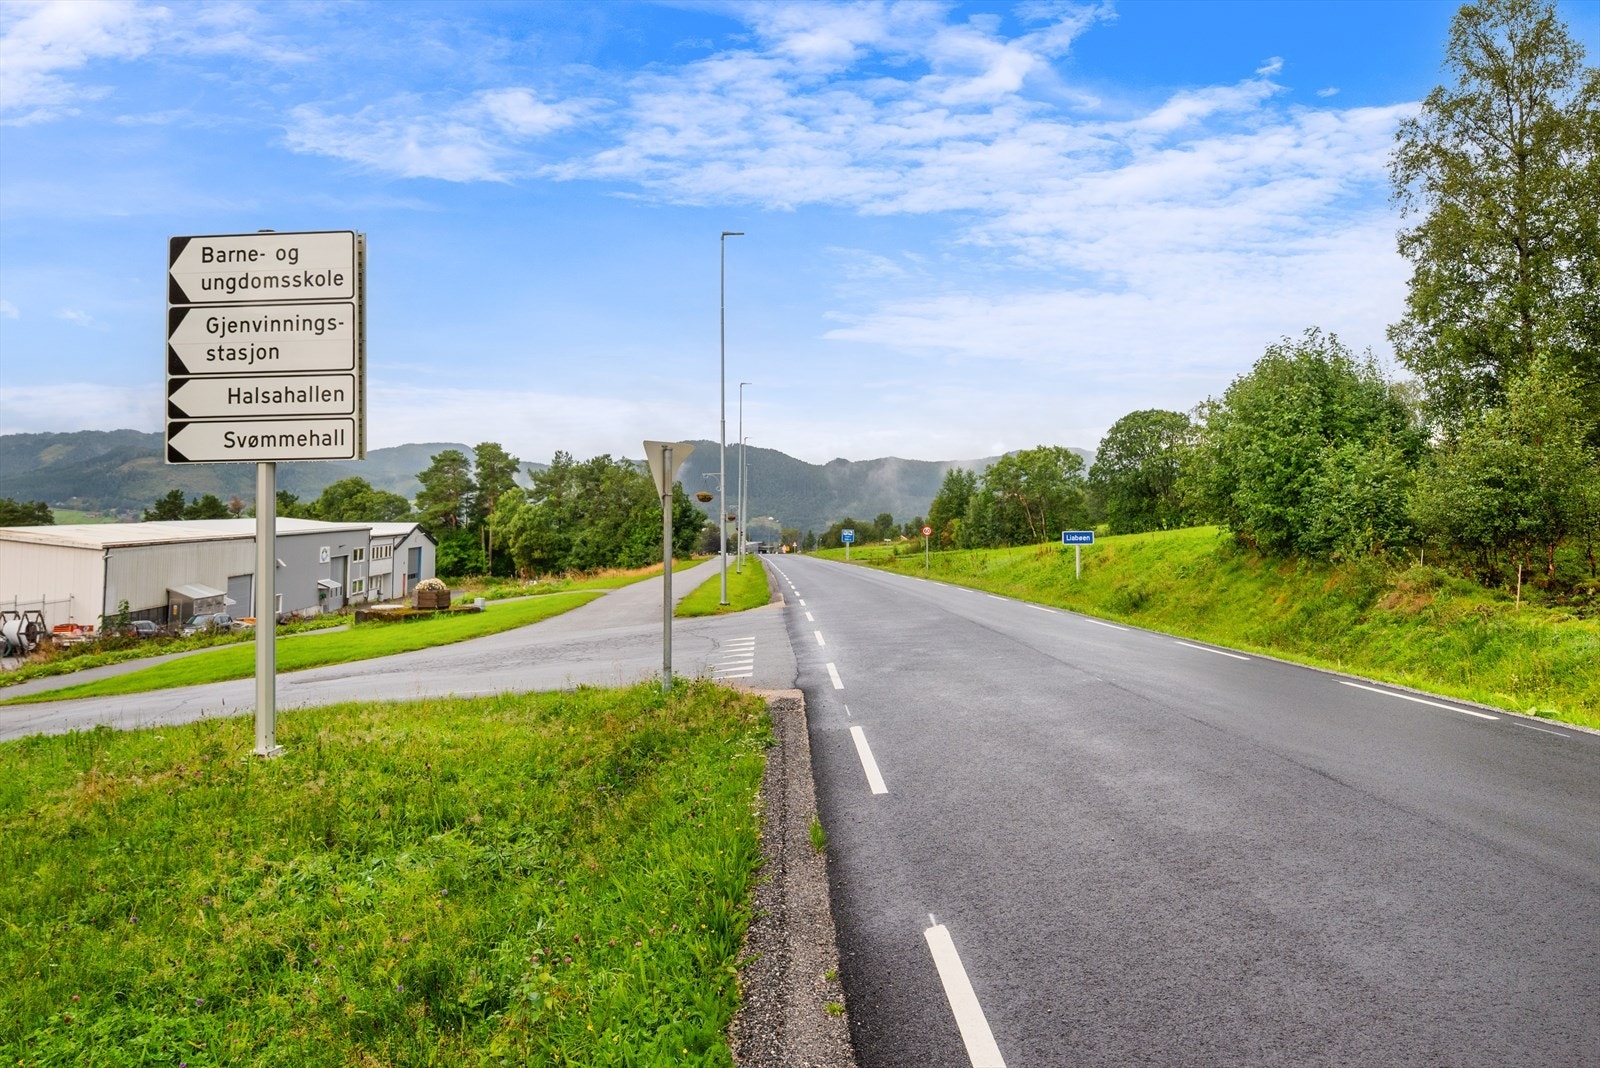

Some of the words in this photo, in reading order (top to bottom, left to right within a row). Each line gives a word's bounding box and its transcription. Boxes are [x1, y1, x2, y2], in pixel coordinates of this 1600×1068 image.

[201, 246, 266, 263] Barne-
[275, 247, 299, 265] og
[201, 270, 344, 294] ungdomsskole
[206, 315, 344, 338] Gjenvinnings-
[206, 343, 280, 365] stasjon
[228, 385, 344, 404] Halsahallen
[223, 429, 344, 448] Svømmehall
